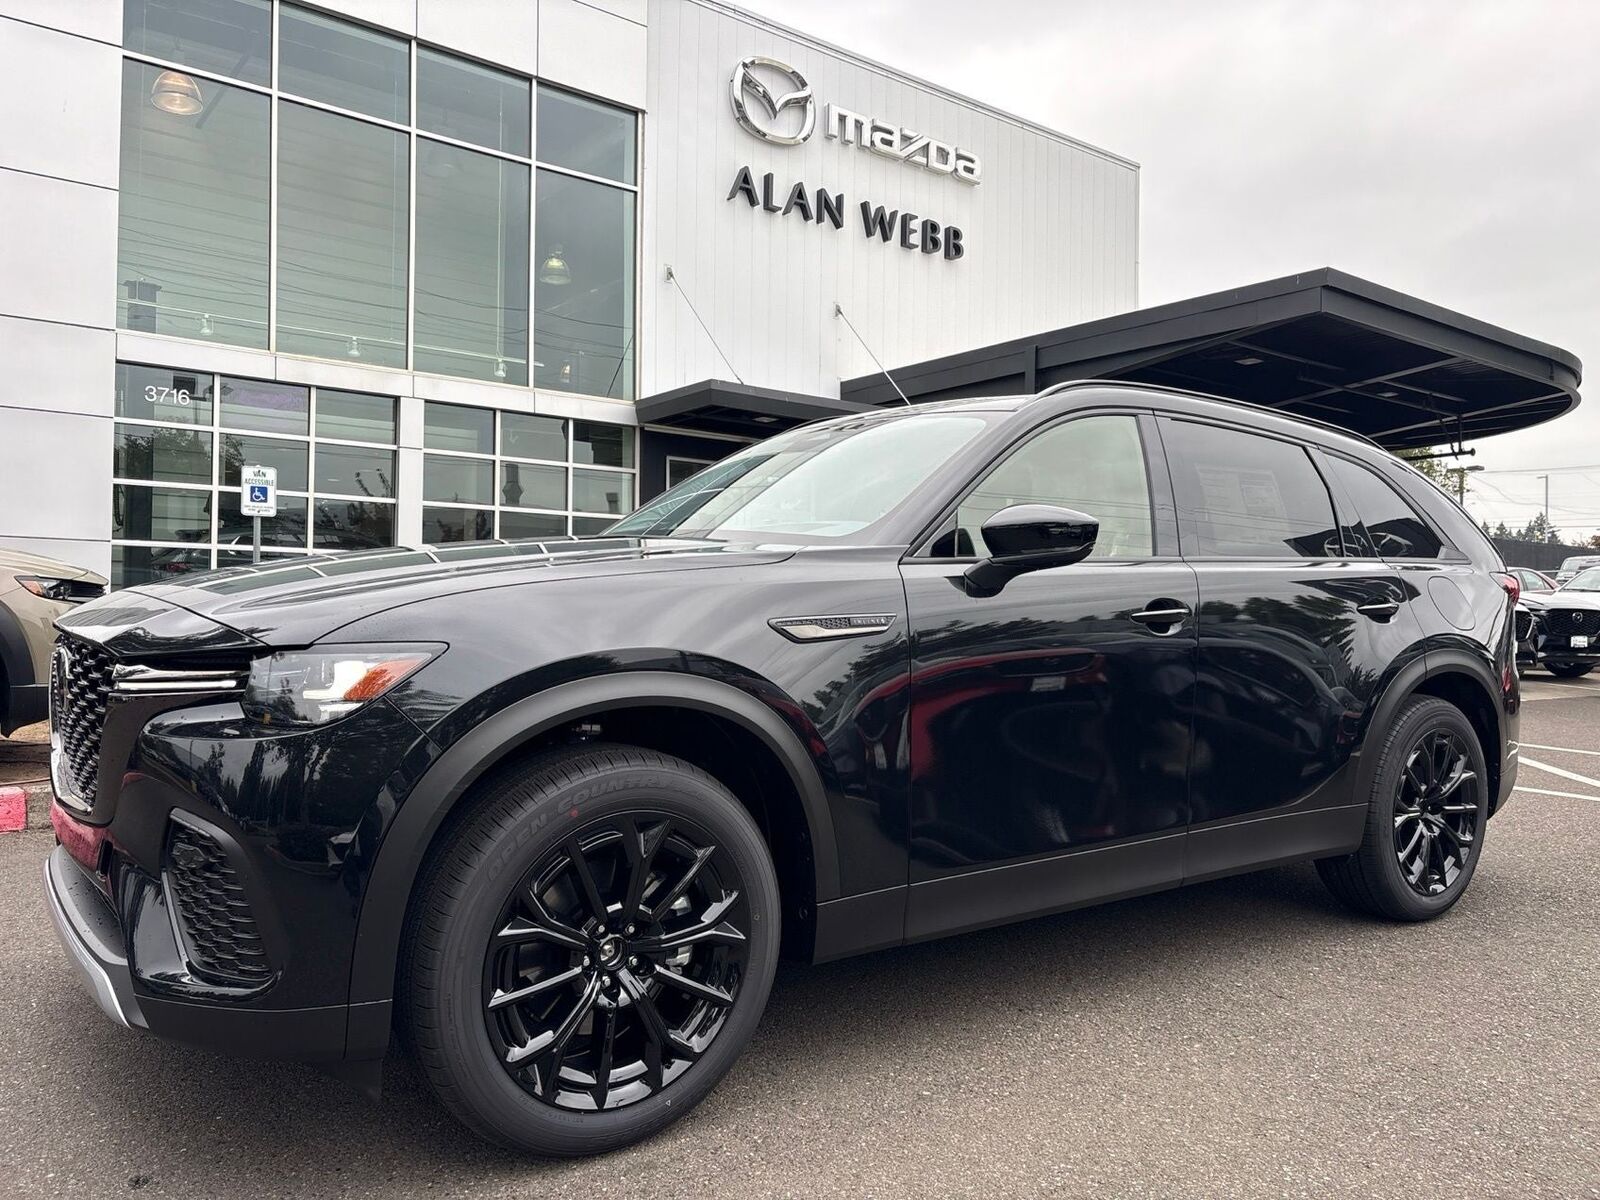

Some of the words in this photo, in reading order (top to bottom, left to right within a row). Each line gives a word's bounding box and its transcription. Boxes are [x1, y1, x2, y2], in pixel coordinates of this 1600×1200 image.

[824, 102, 981, 185] mazda
[727, 165, 844, 230] ALAN
[860, 201, 964, 261] WEBB
[144, 385, 190, 406] 3716
[245, 478, 274, 486] ACCESSIBLE
[253, 470, 267, 478] VAN
